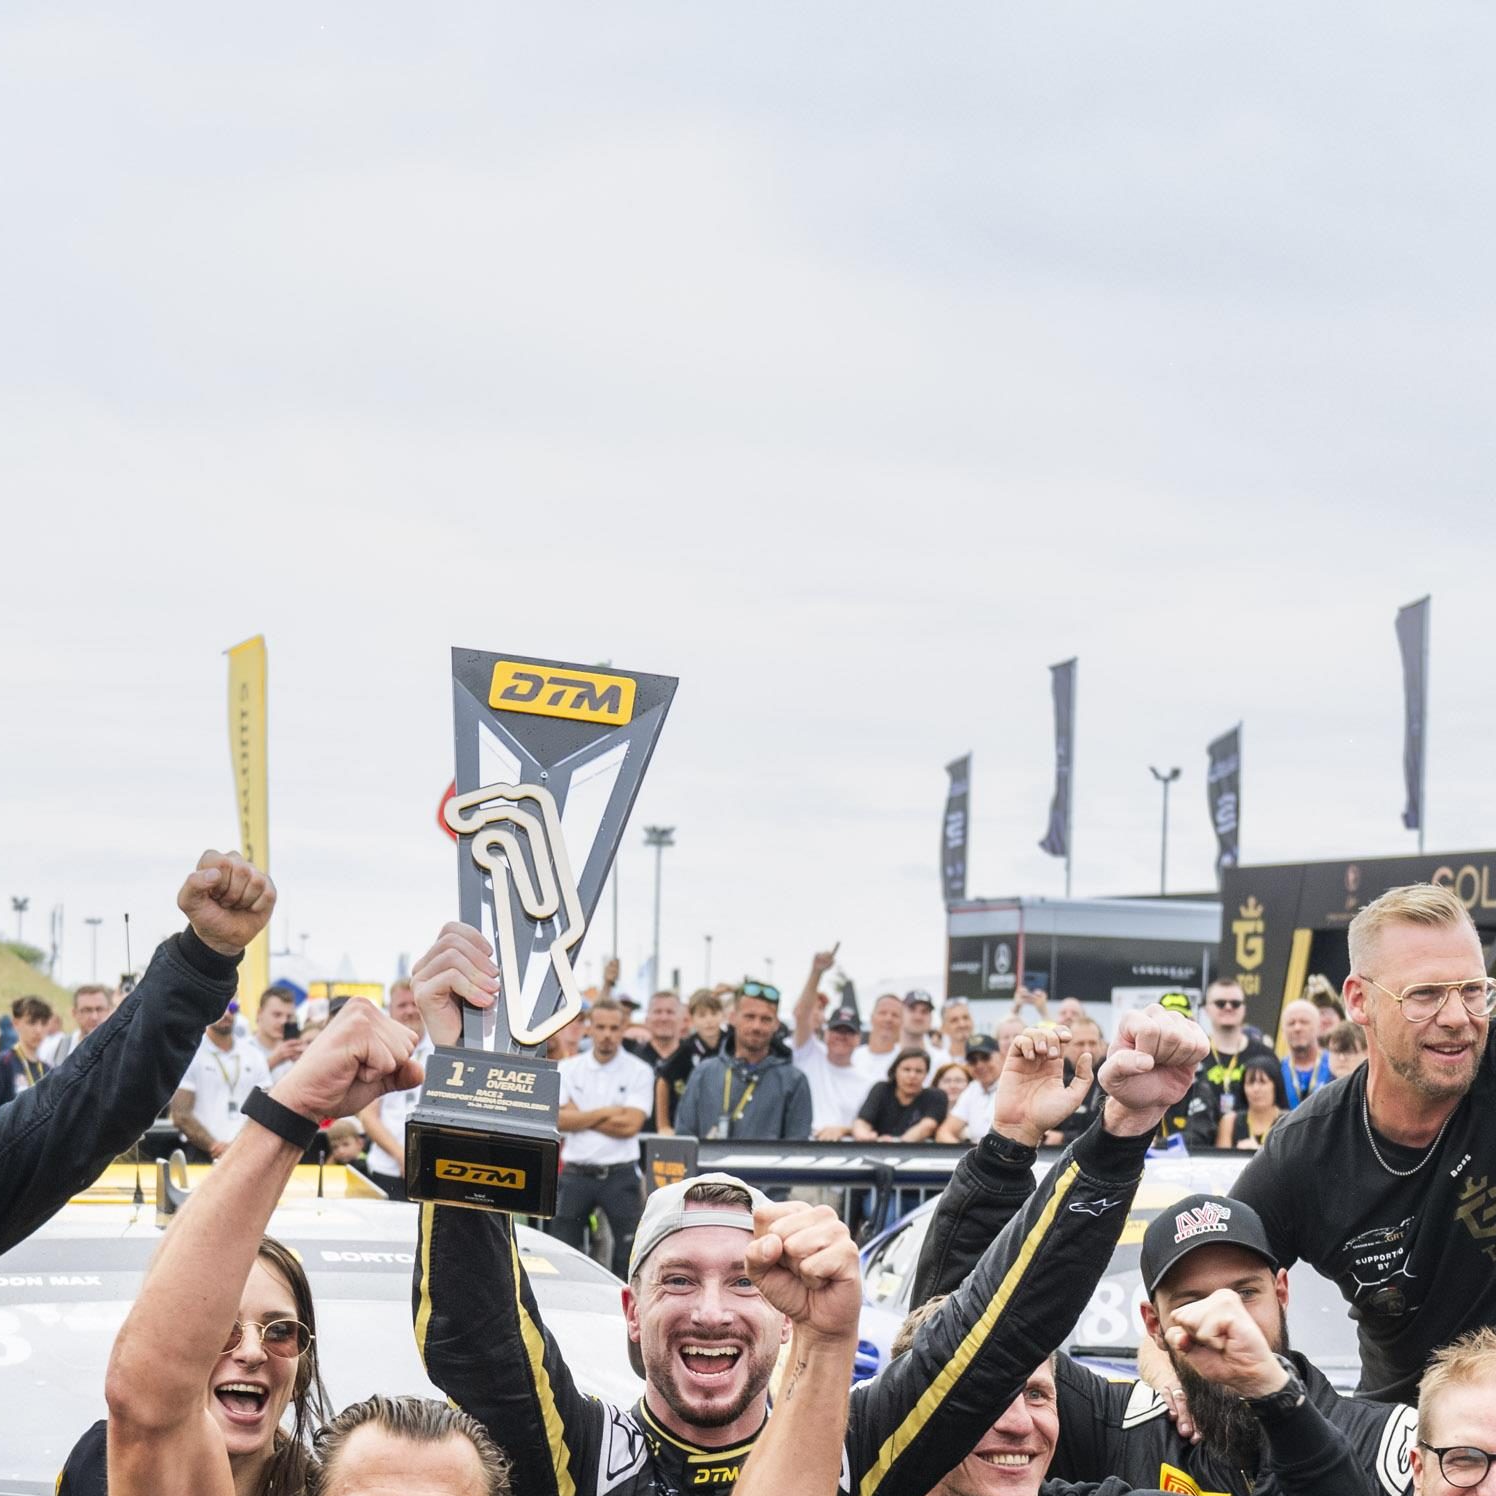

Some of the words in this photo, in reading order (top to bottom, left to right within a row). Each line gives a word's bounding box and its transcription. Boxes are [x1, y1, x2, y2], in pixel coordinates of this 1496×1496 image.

[499, 672, 623, 714] DTM
[487, 1068, 537, 1085] PLACE
[486, 1079, 534, 1095] OVERALL
[442, 1164, 518, 1185] DTM
[1377, 1262, 1391, 1272] BY
[49, 1276, 102, 1286] MAX
[693, 1466, 740, 1484] DTM
